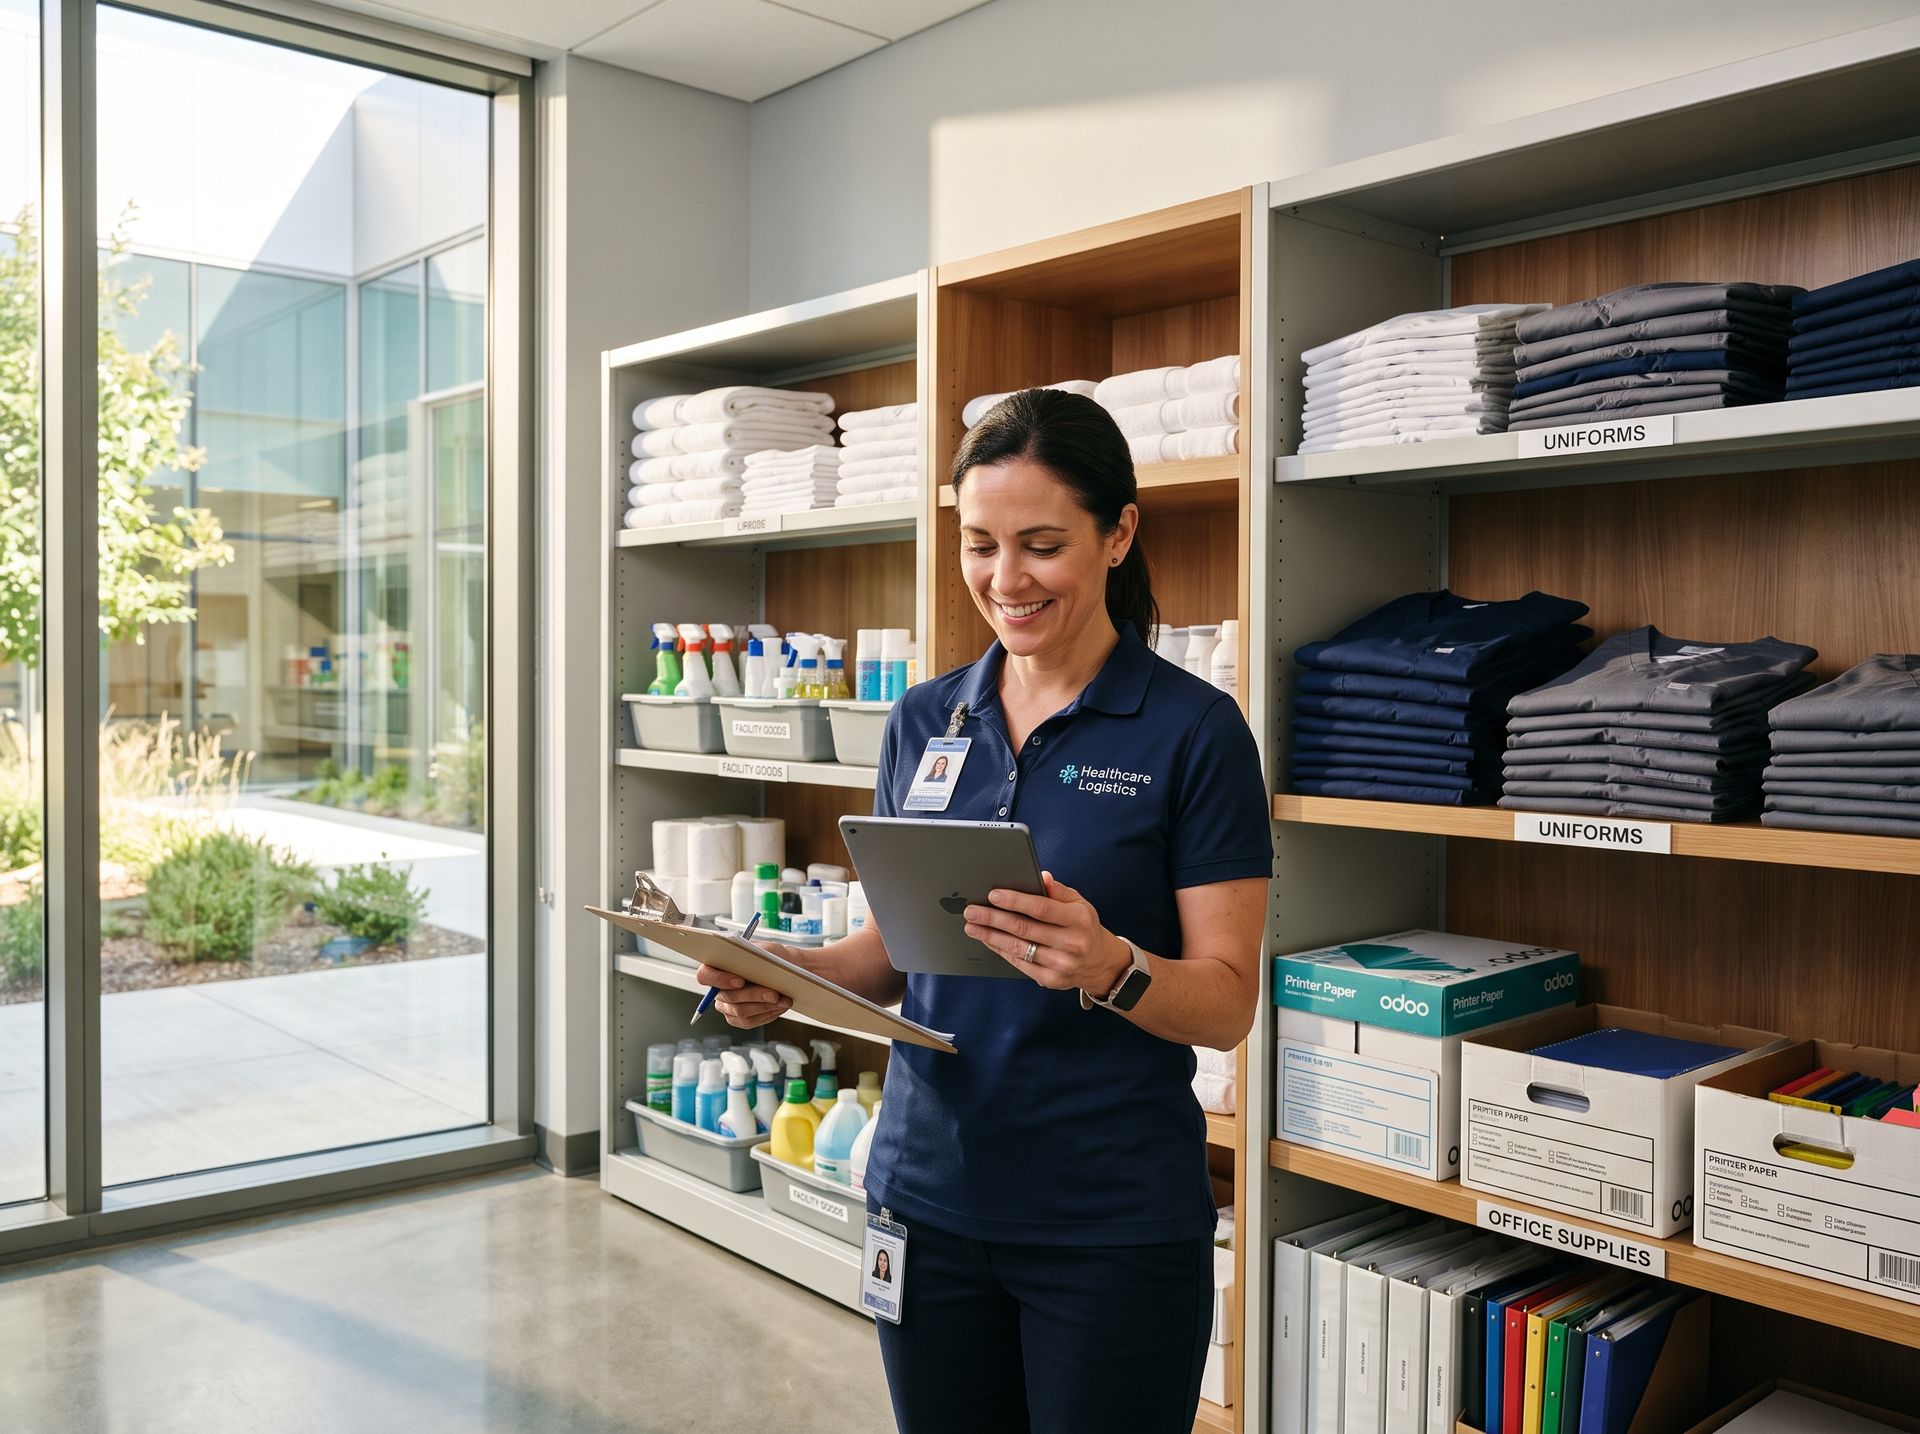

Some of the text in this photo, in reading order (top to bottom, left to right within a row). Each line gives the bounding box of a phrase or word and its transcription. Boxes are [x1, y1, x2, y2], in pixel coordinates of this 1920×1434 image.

[1544, 424, 1646, 450] UNIFORMS
[763, 725, 787, 736] GOODS
[722, 762, 783, 777] FACILITY GOODS
[1081, 765, 1152, 784] Healthcare
[1078, 779, 1137, 796] Logistics
[1539, 821, 1643, 844] UNIFORMS
[1285, 974, 1322, 991] Printer
[1323, 981, 1357, 999] Paper
[1544, 972, 1574, 992] odoo
[1380, 994, 1430, 1017] odoo
[1453, 989, 1504, 1011] Printer Paper
[1505, 1111, 1529, 1123] PAPER
[1748, 1165, 1778, 1178] PAPER
[1488, 1210, 1651, 1267] OFFICE SUPPLIES
